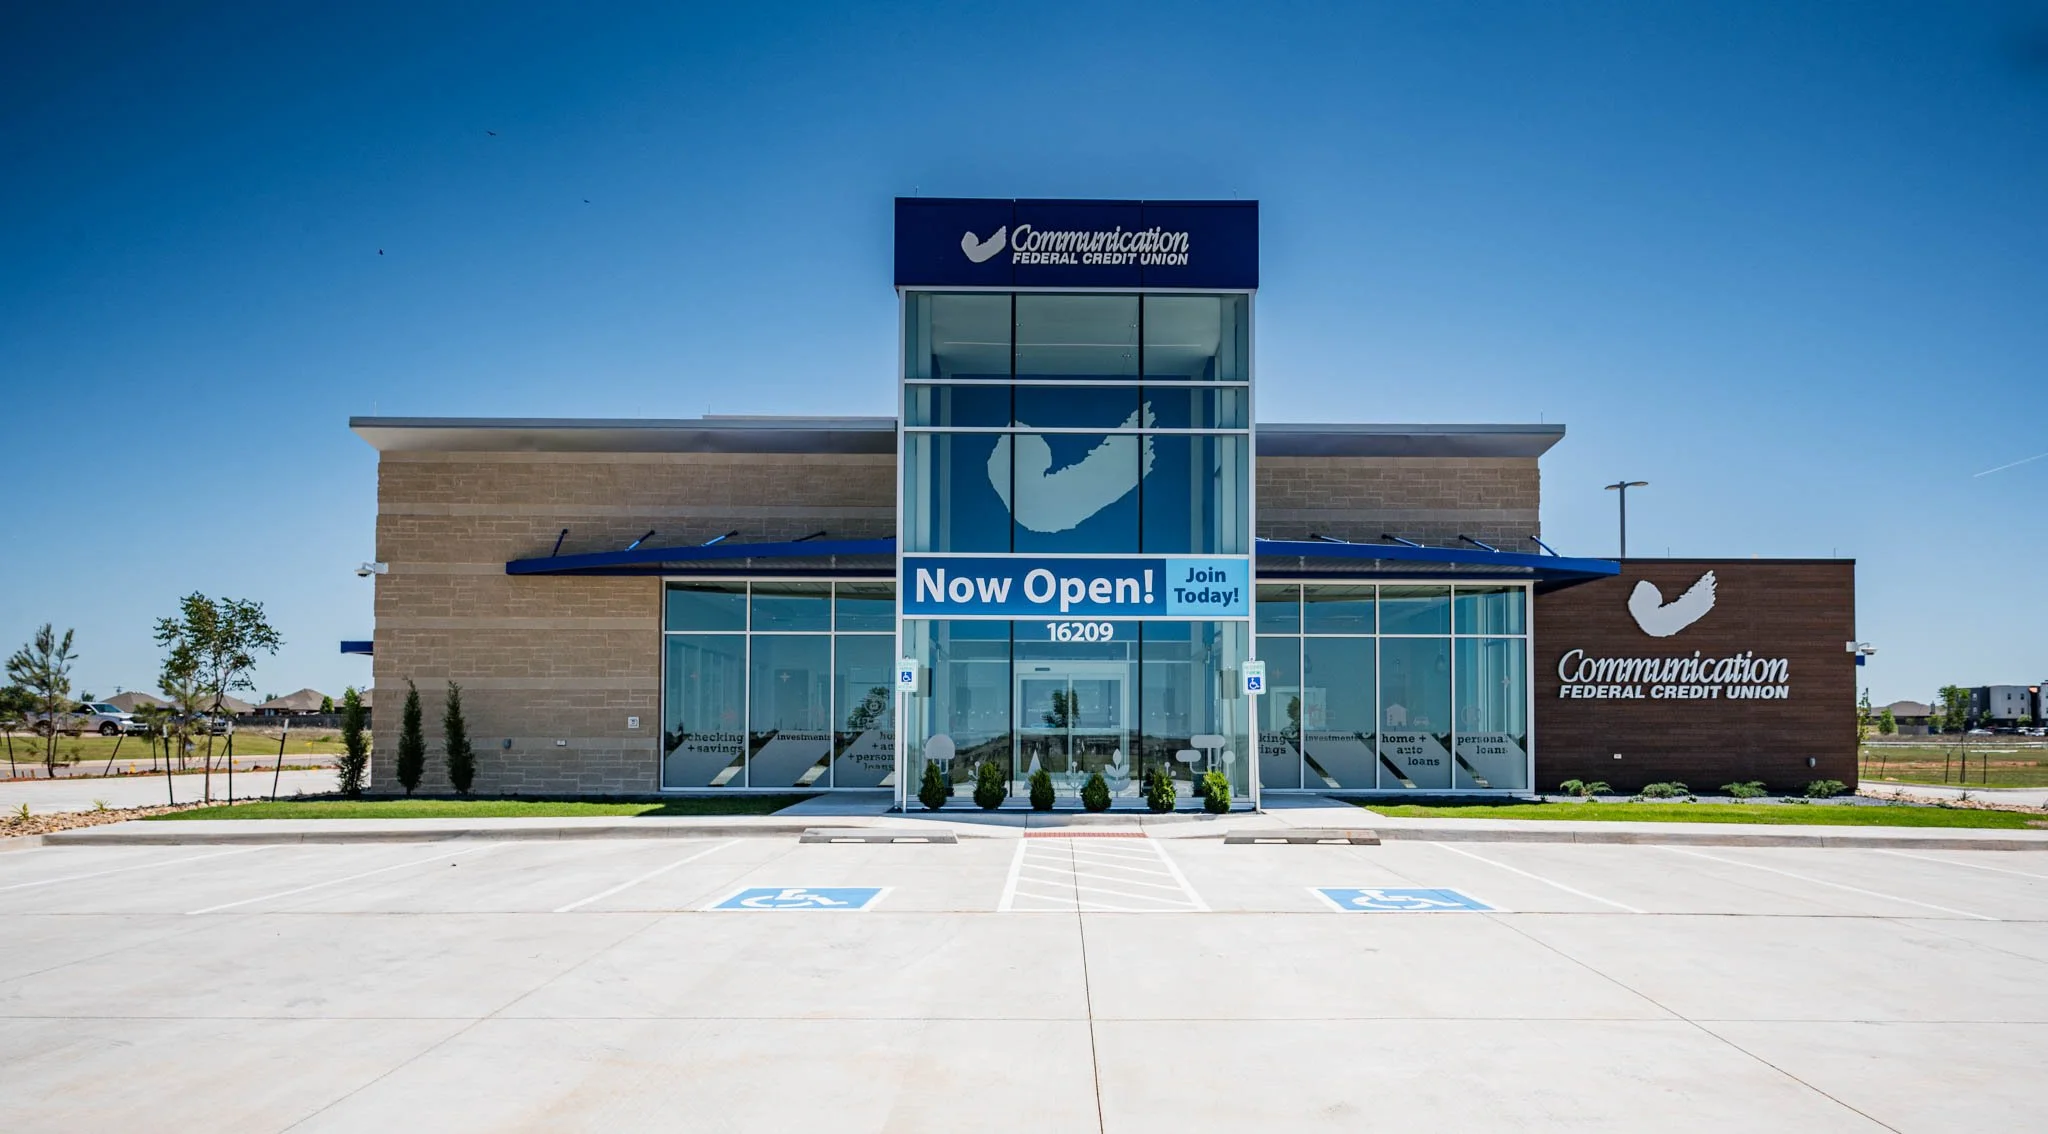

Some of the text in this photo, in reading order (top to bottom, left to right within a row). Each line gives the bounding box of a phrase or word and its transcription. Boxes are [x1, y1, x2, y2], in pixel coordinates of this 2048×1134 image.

[1011, 224, 1189, 253] Communication
[1012, 252, 1189, 266] FEDERAL CREDIT UNION
[1185, 567, 1227, 583] Join
[916, 568, 1155, 613] Now Open!
[1173, 587, 1239, 607] Today!
[1046, 622, 1114, 642] 16209
[1557, 649, 1789, 683] Communication
[1559, 685, 1790, 699] FEDERAL CREDIT UNION
[687, 732, 744, 744] checking
[777, 733, 831, 741] investments
[1259, 732, 1286, 745] king
[1382, 733, 1415, 743] home
[1258, 744, 1287, 756] ings
[1396, 746, 1424, 754] auto
[1476, 745, 1509, 754] loans
[1407, 756, 1440, 766] loans
